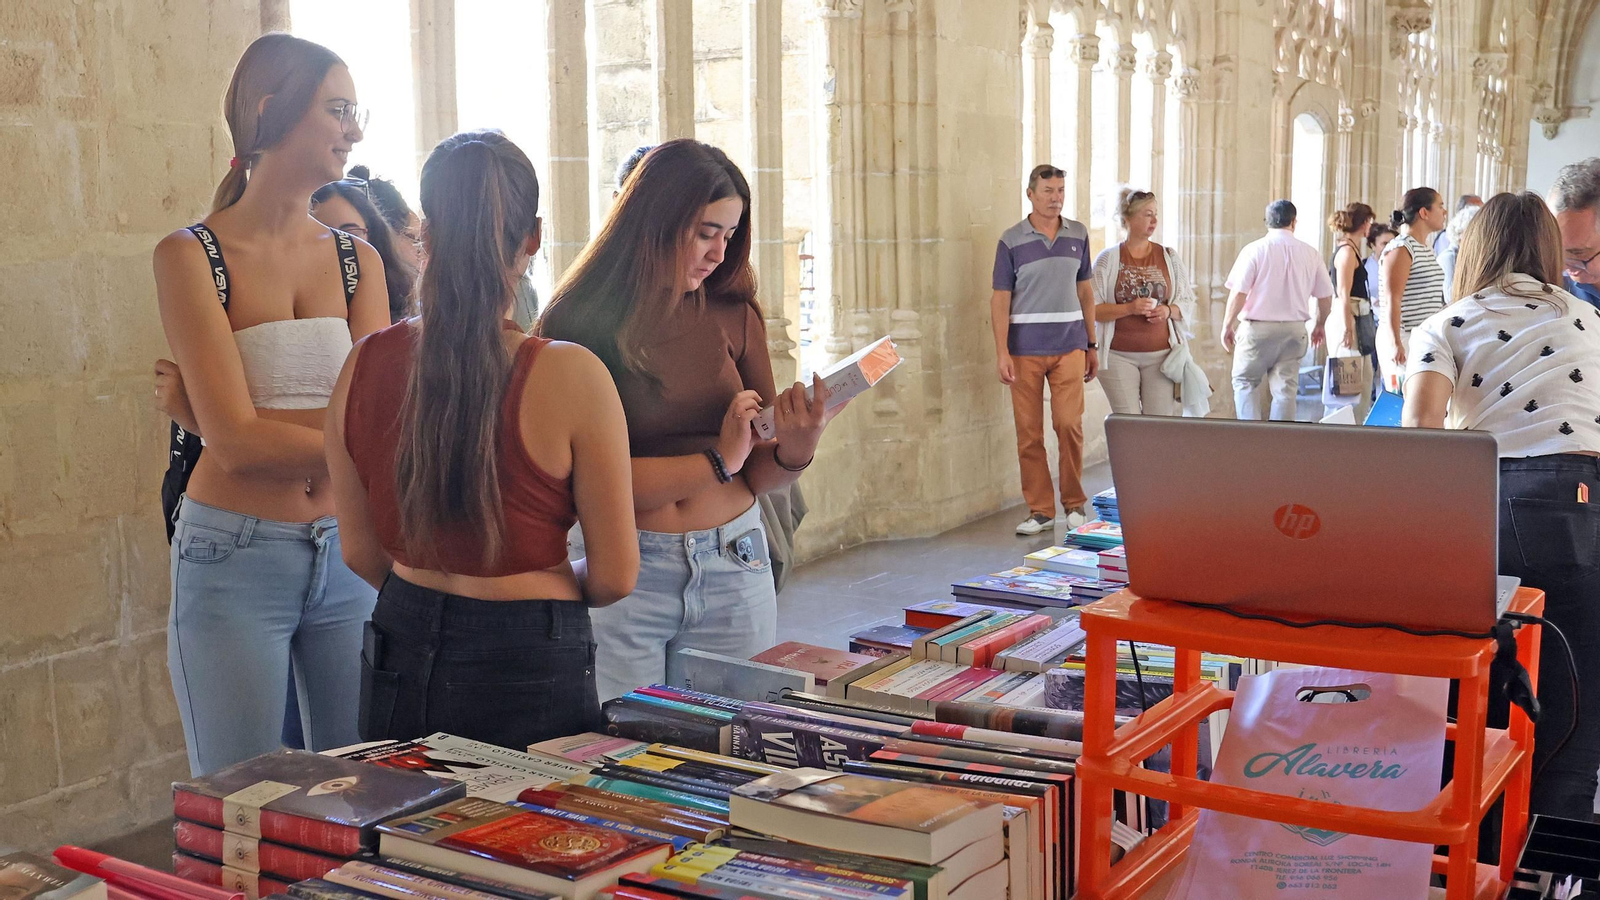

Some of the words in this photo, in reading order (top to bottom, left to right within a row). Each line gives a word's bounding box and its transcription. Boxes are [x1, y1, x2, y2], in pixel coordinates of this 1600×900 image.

[731, 724, 741, 756] HANNAH
[492, 748, 542, 764] CASTILLO
[1243, 743, 1409, 780] Alavera
[476, 757, 527, 774] CASTILLO
[544, 760, 583, 773] JAVIER
[541, 807, 565, 819] MATT
[565, 811, 589, 822] HAIG
[602, 820, 615, 828] LA
[616, 823, 635, 833] VIDA
[1244, 850, 1274, 858] CENTRO
